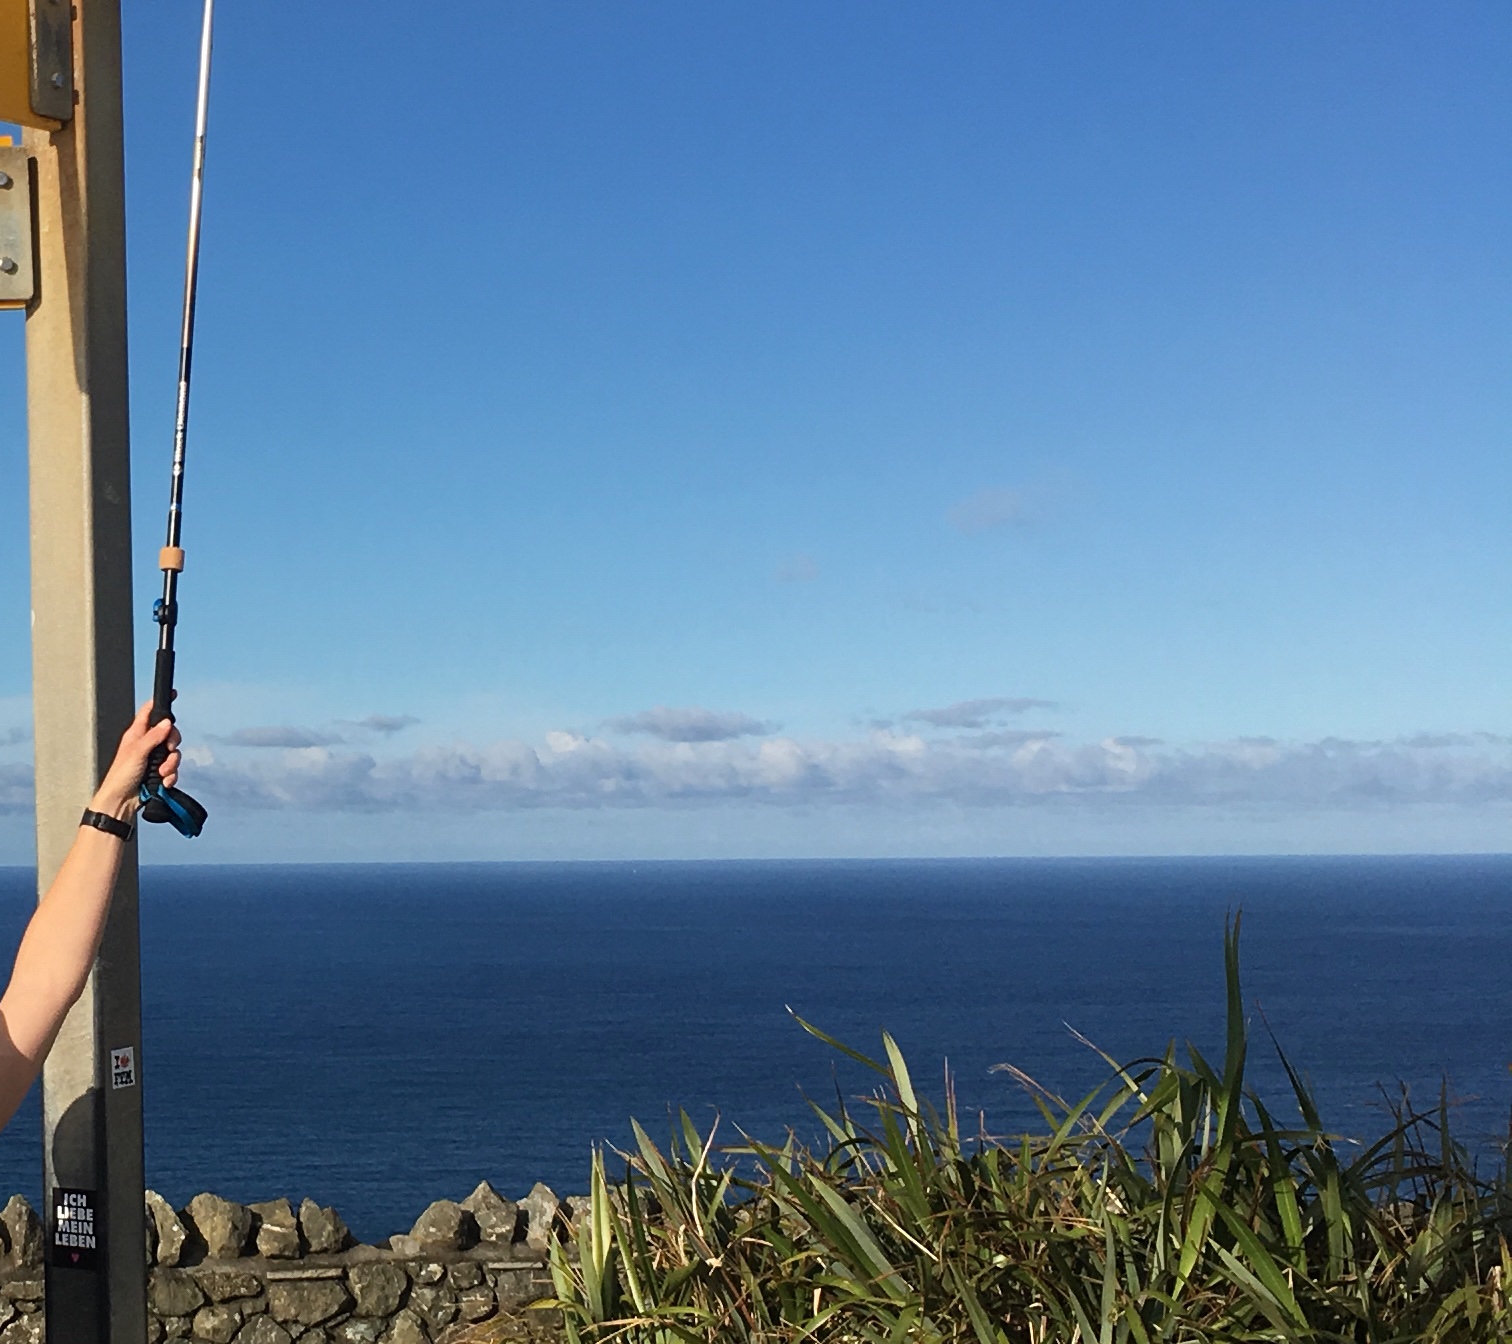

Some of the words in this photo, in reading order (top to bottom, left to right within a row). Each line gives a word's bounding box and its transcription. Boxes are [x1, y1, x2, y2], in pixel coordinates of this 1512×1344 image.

[63, 1192, 87, 1207] ICH
[56, 1205, 94, 1222] LIEBE
[57, 1219, 94, 1235] MEIN
[55, 1232, 96, 1249] LEBEN
